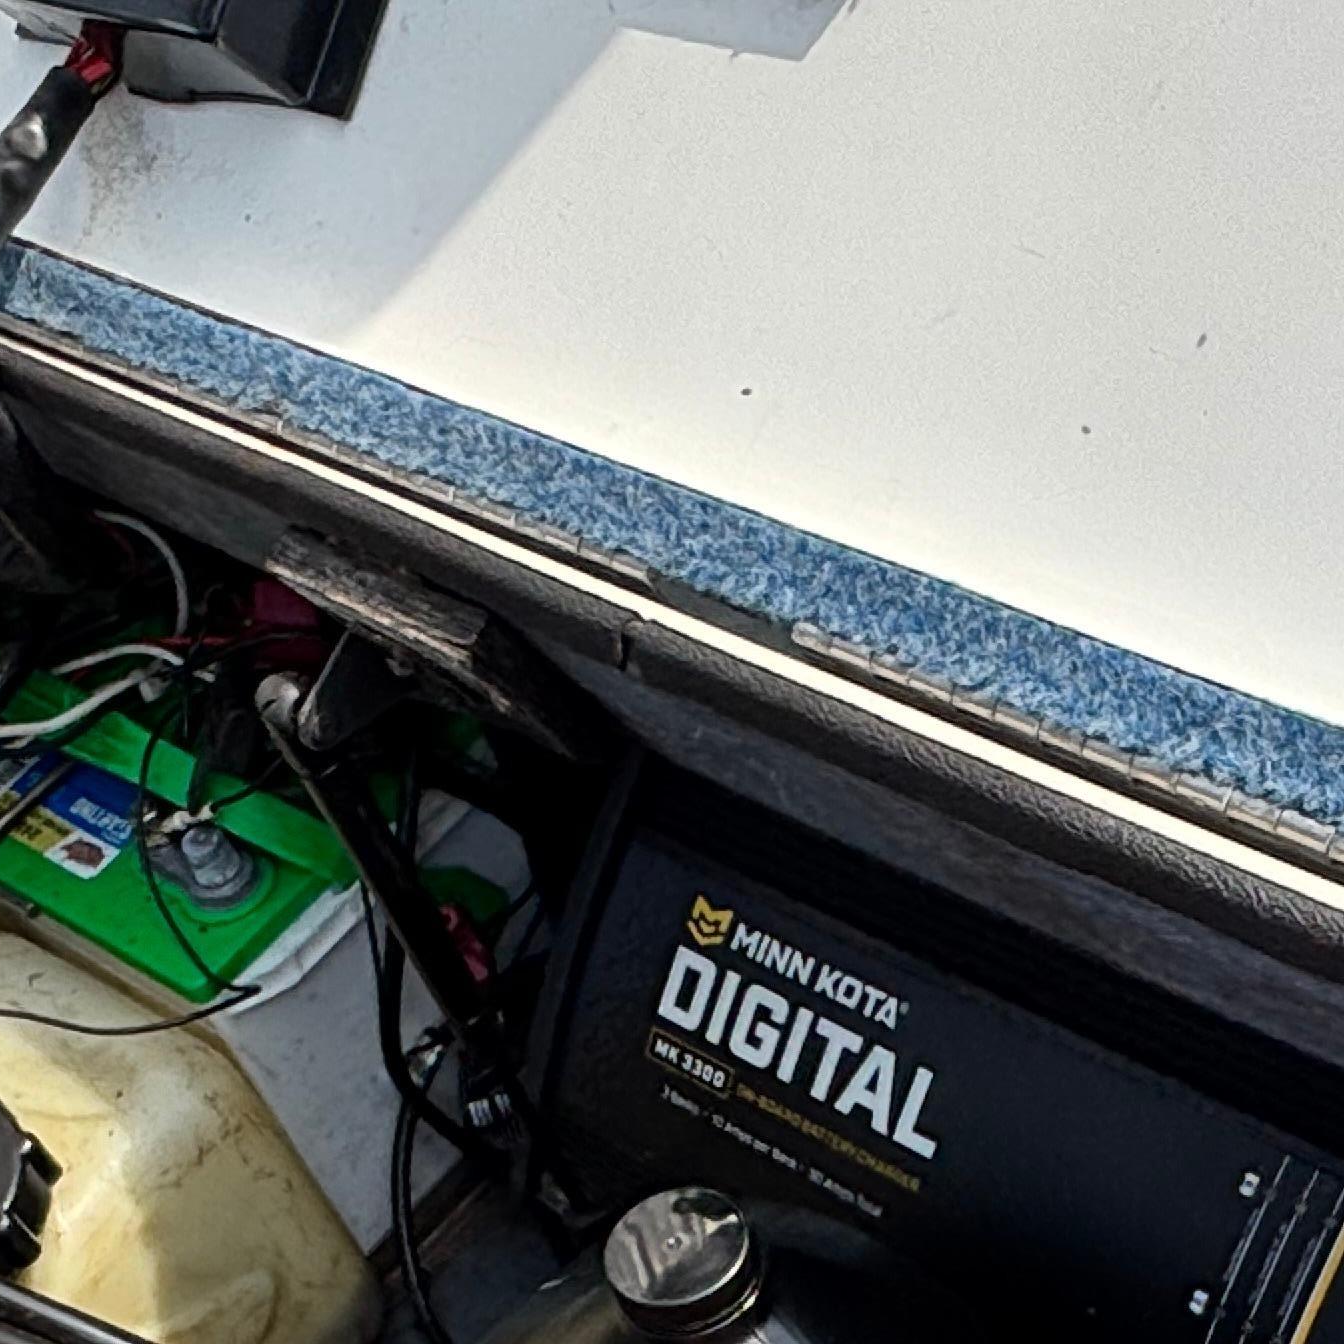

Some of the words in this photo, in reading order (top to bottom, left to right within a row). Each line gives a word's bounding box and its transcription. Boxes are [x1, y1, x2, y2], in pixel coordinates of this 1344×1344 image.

[656, 945, 938, 1160] DIGITAL
[730, 921, 815, 984] MINN
[815, 960, 898, 1031] KOTA
